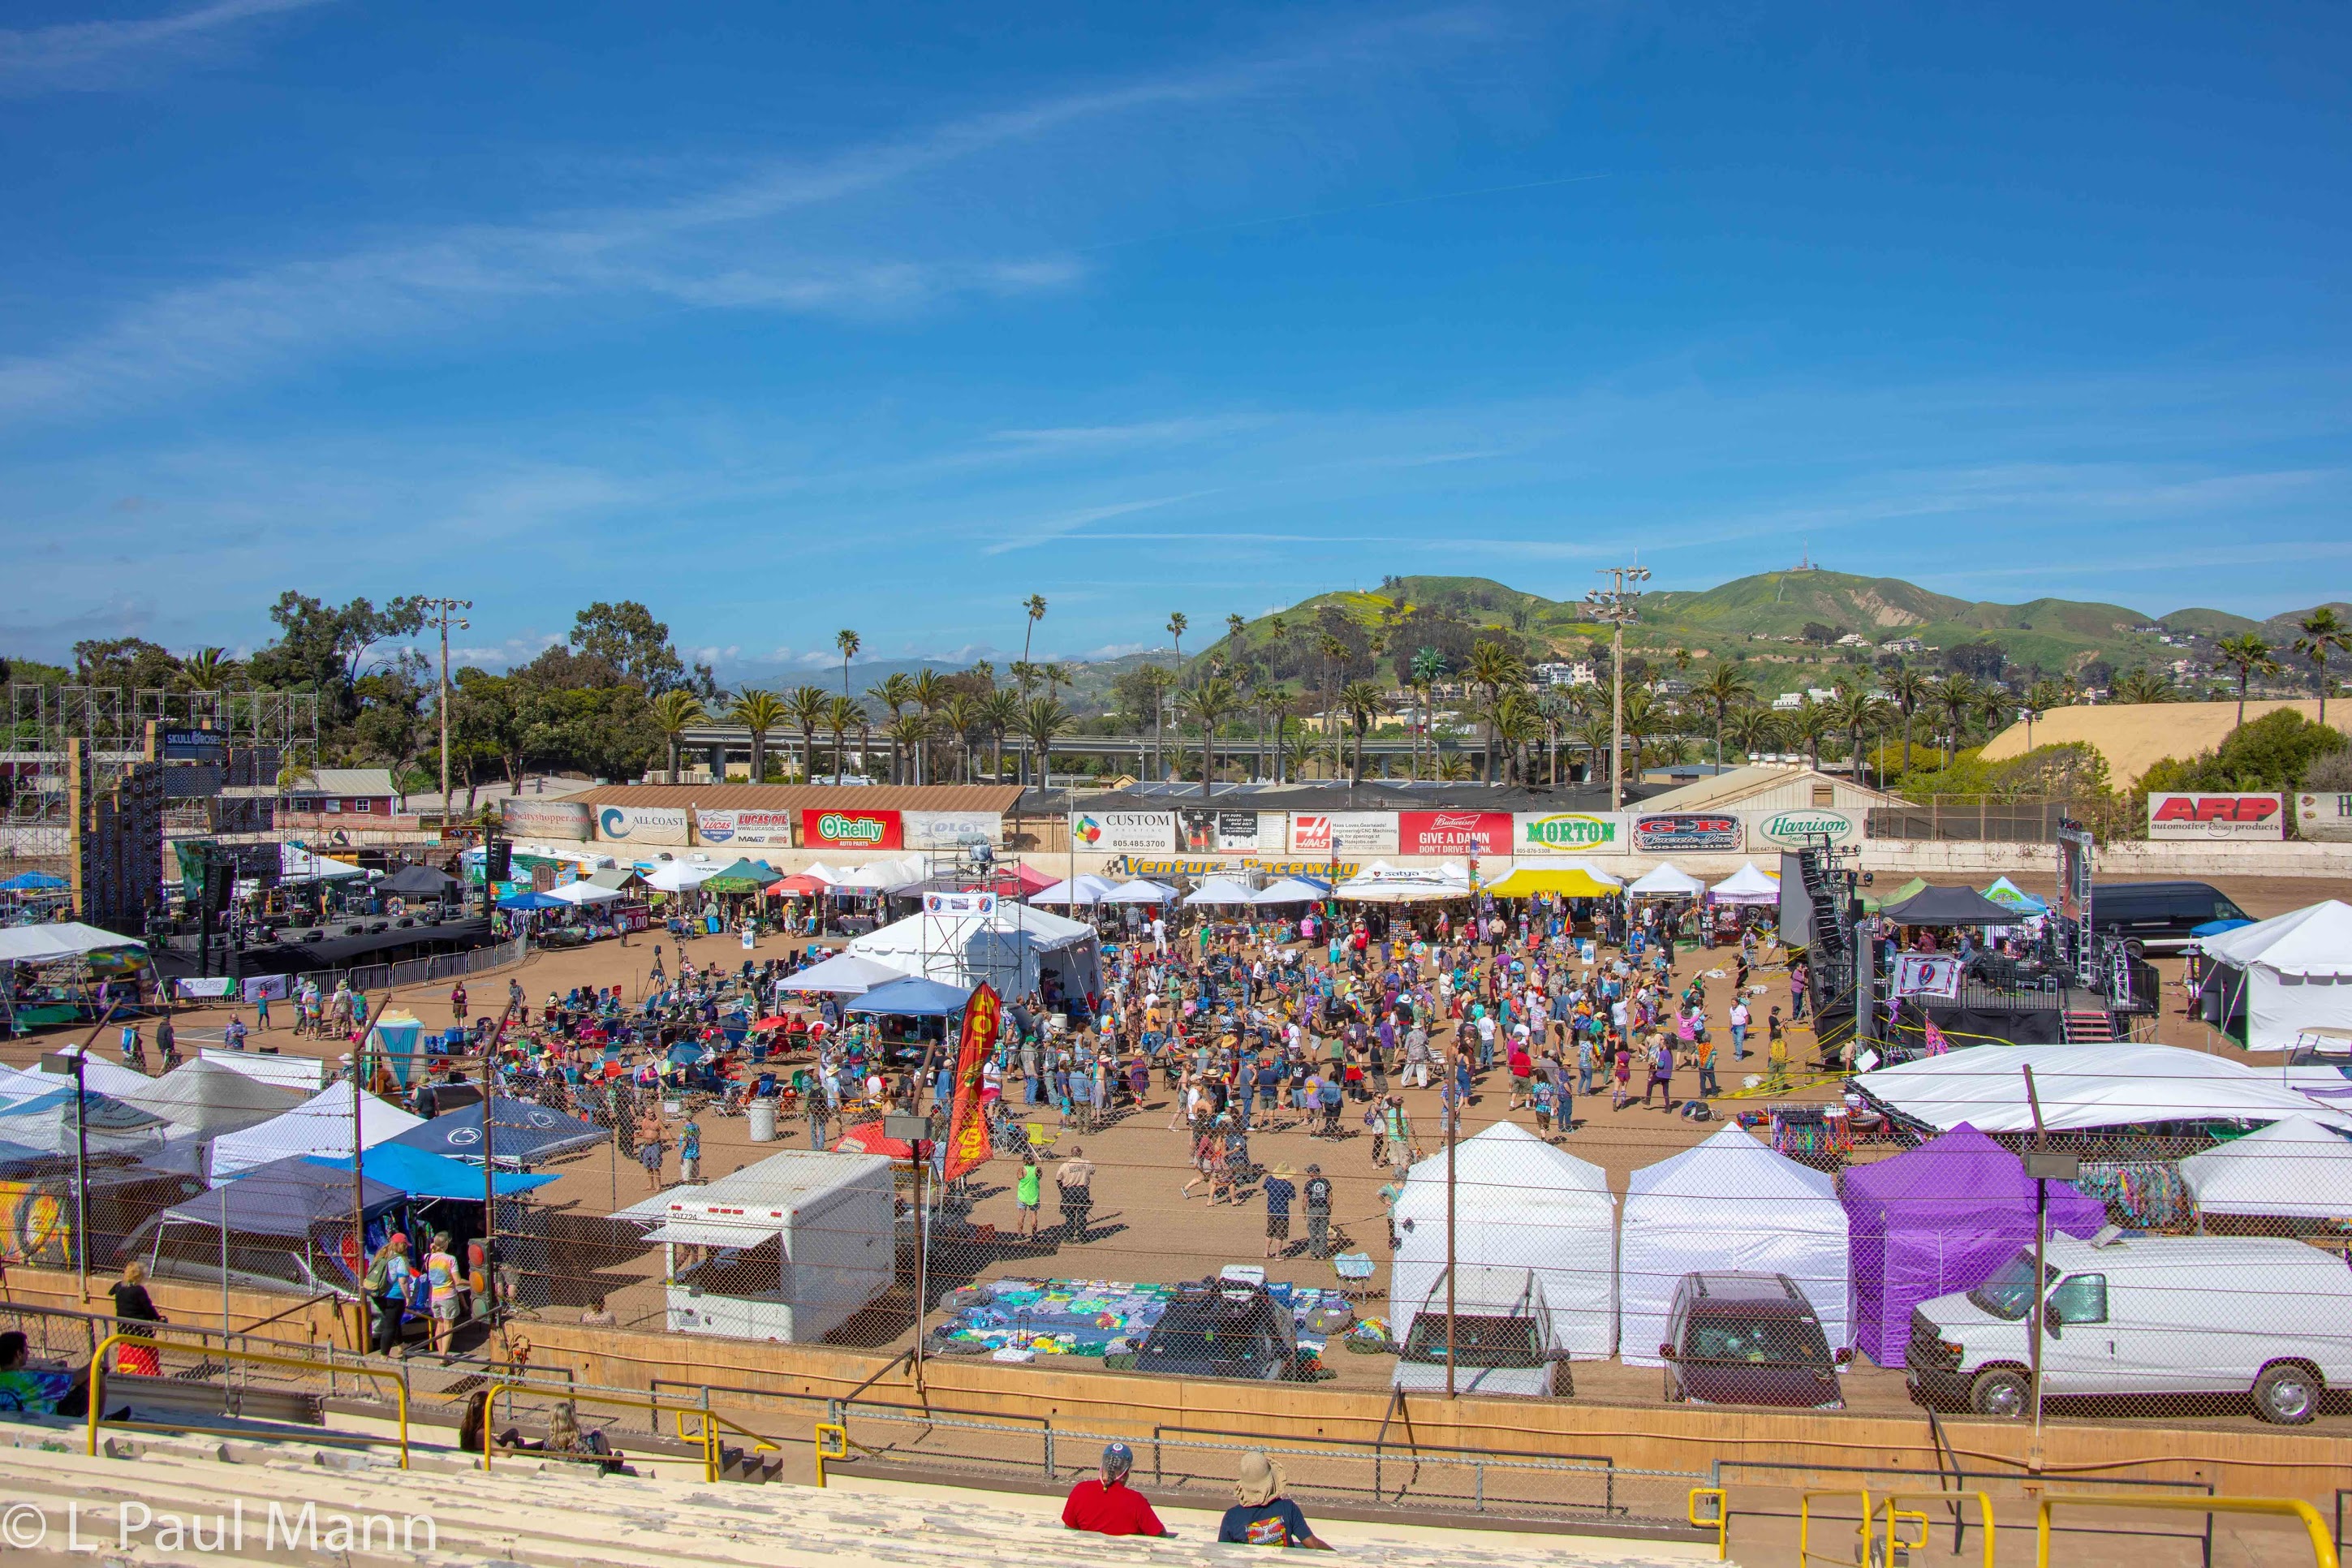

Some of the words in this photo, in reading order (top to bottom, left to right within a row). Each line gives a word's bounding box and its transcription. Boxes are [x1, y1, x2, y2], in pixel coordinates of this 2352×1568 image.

[167, 734, 192, 744] SKULL
[200, 734, 221, 745] ROSES
[2152, 798, 2279, 822] ARP
[510, 812, 588, 824] gocityshopper.com
[632, 816, 648, 825] ALL
[652, 816, 685, 826] COAST
[737, 813, 770, 825] LUCAS
[770, 813, 788, 825] OIL
[1106, 814, 1170, 826] CUSTOM
[1435, 817, 1475, 826] Budweiser
[820, 815, 883, 842] O'Reilly
[934, 822, 971, 833] DLG
[1526, 821, 1616, 842] MORTON
[1639, 820, 1677, 834] G
[1691, 820, 1734, 833] R
[1770, 816, 1848, 836] Harrison
[2151, 822, 2205, 830] automotive
[2207, 821, 2232, 834] Racing
[2234, 824, 2280, 832] products
[1299, 838, 1328, 848] HAAS
[1419, 832, 1444, 844] GIVE
[1446, 832, 1454, 844] A
[1457, 832, 1489, 844] DAMN
[1643, 834, 1699, 845] Concrete
[1699, 833, 1734, 844] Inc.
[1419, 845, 1441, 854] DON'T
[1442, 845, 1464, 854] DRIVE
[196, 980, 222, 989] OSIRIS
